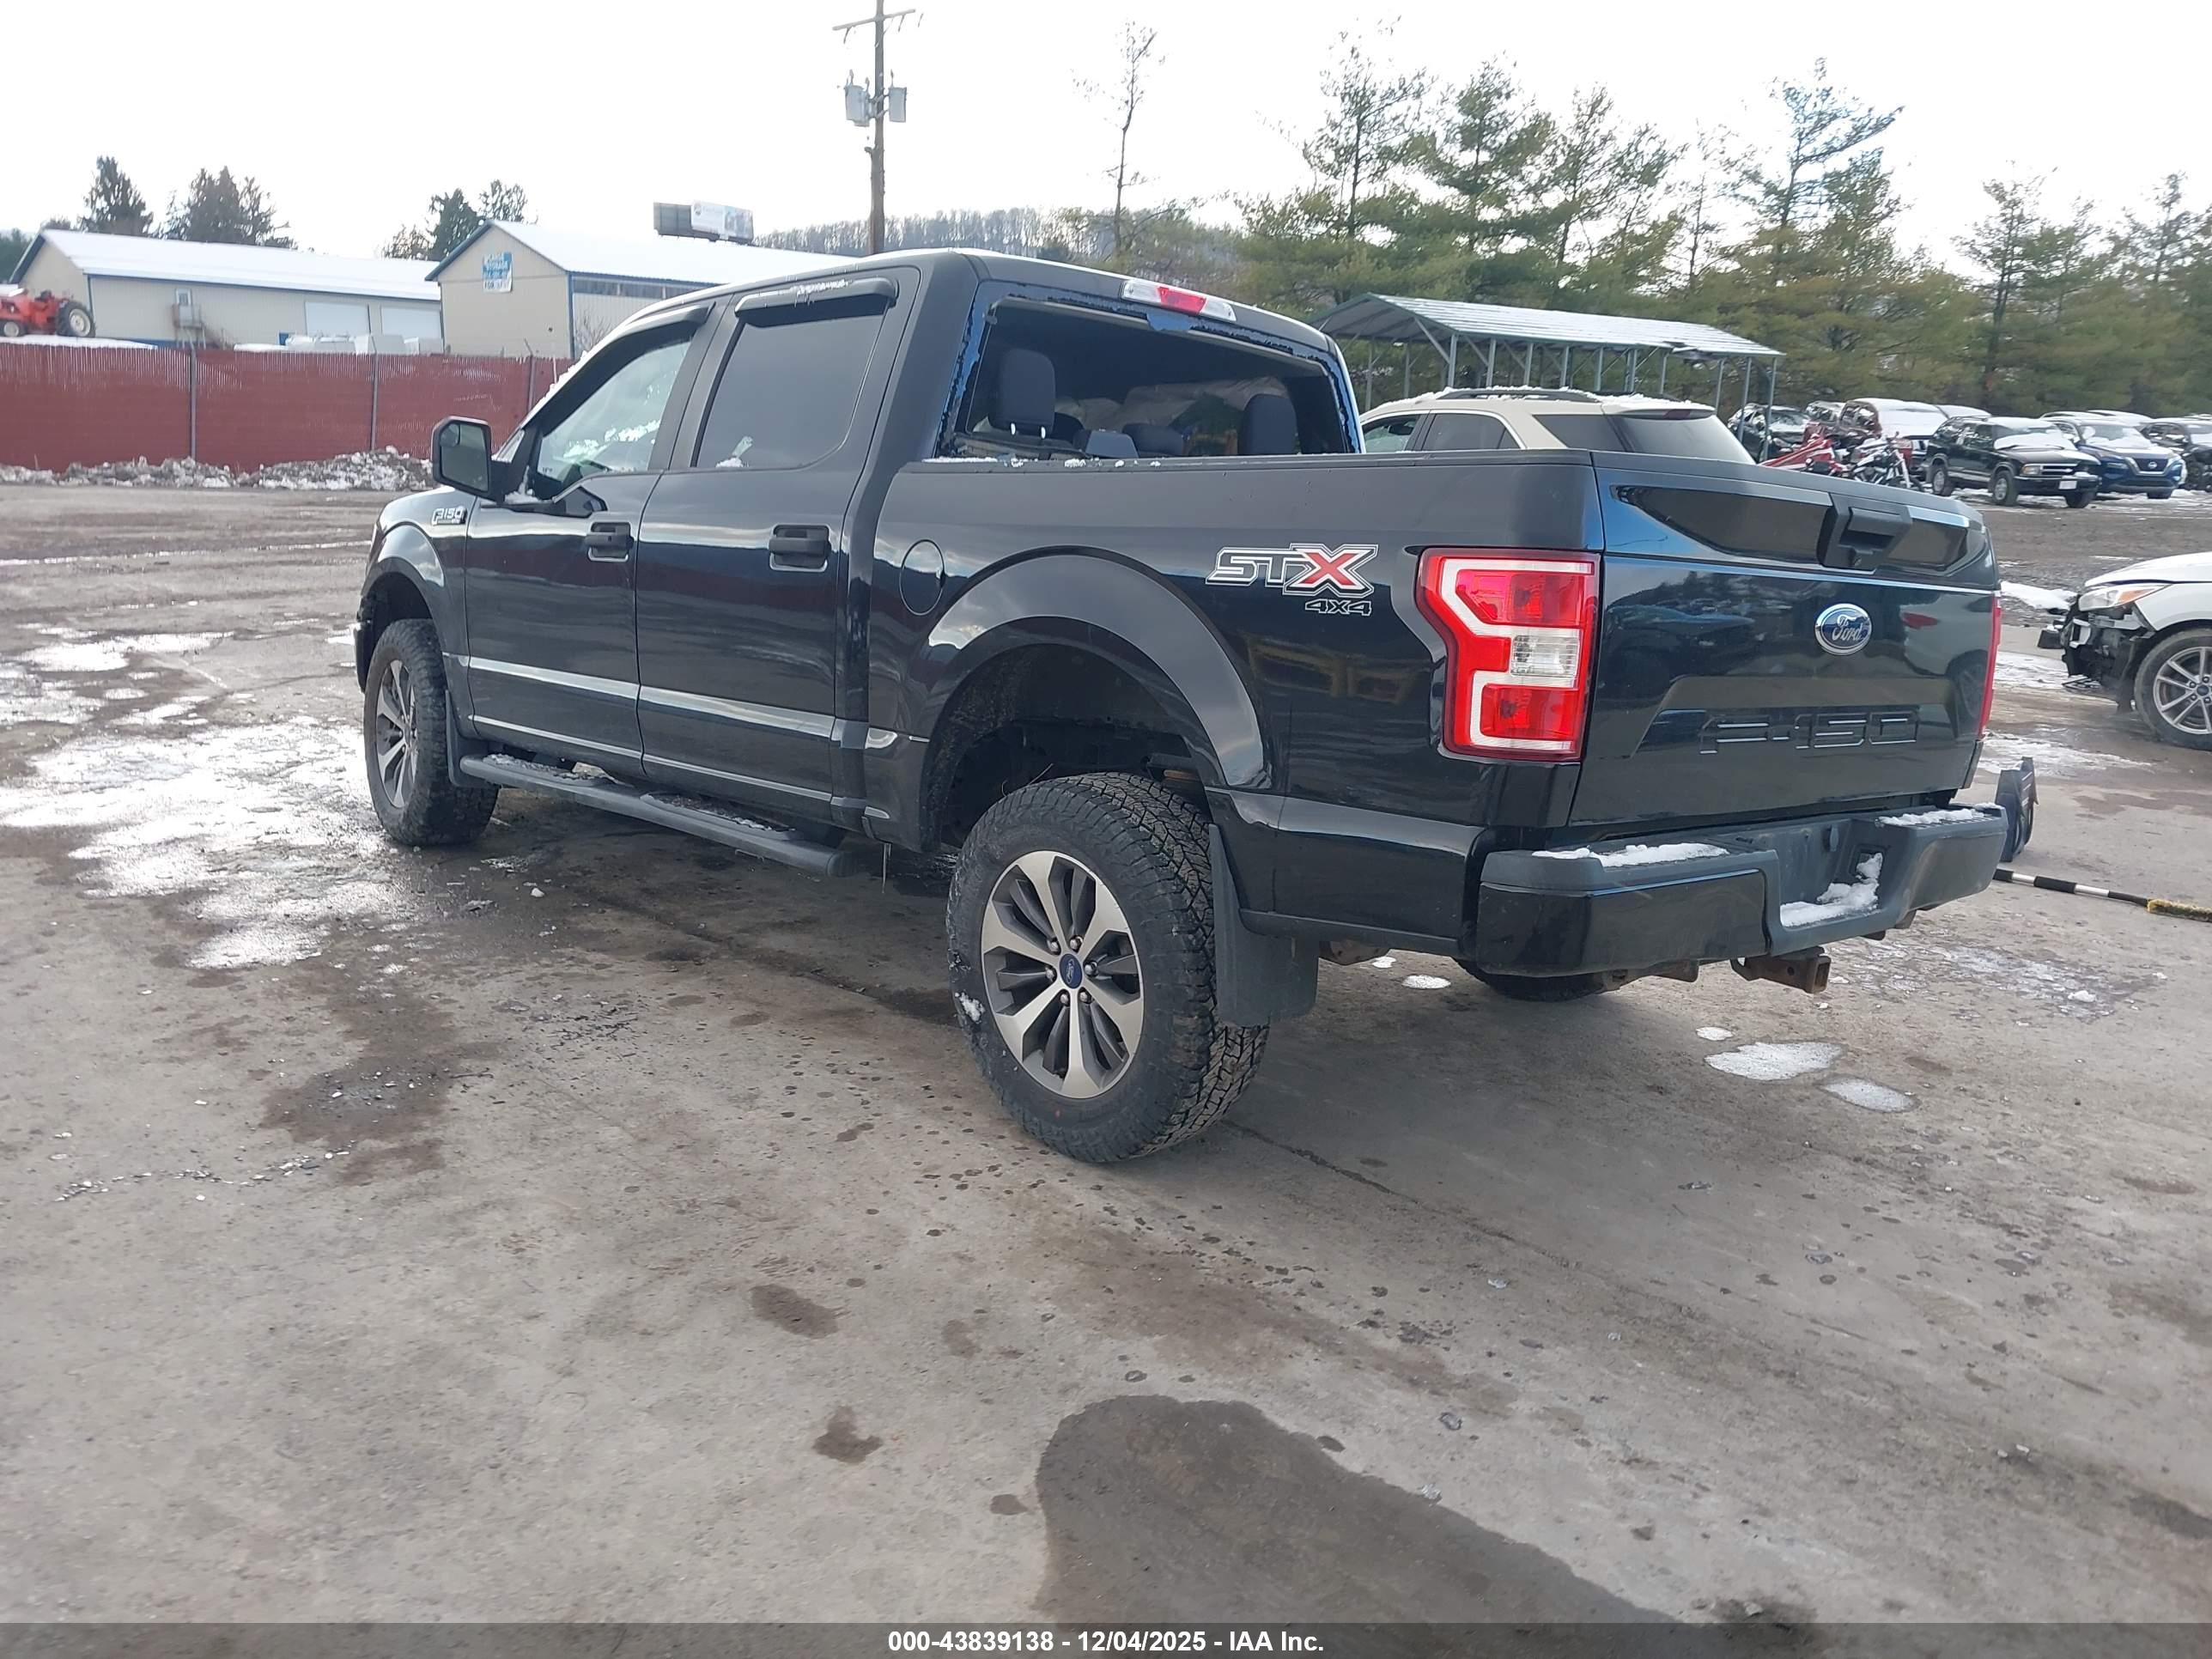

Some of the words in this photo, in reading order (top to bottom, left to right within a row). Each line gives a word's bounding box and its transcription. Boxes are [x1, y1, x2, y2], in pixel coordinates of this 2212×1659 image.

[1206, 544, 1379, 599] STX
[1832, 614, 1863, 641] Ford
[1699, 712, 1919, 754] F-150
